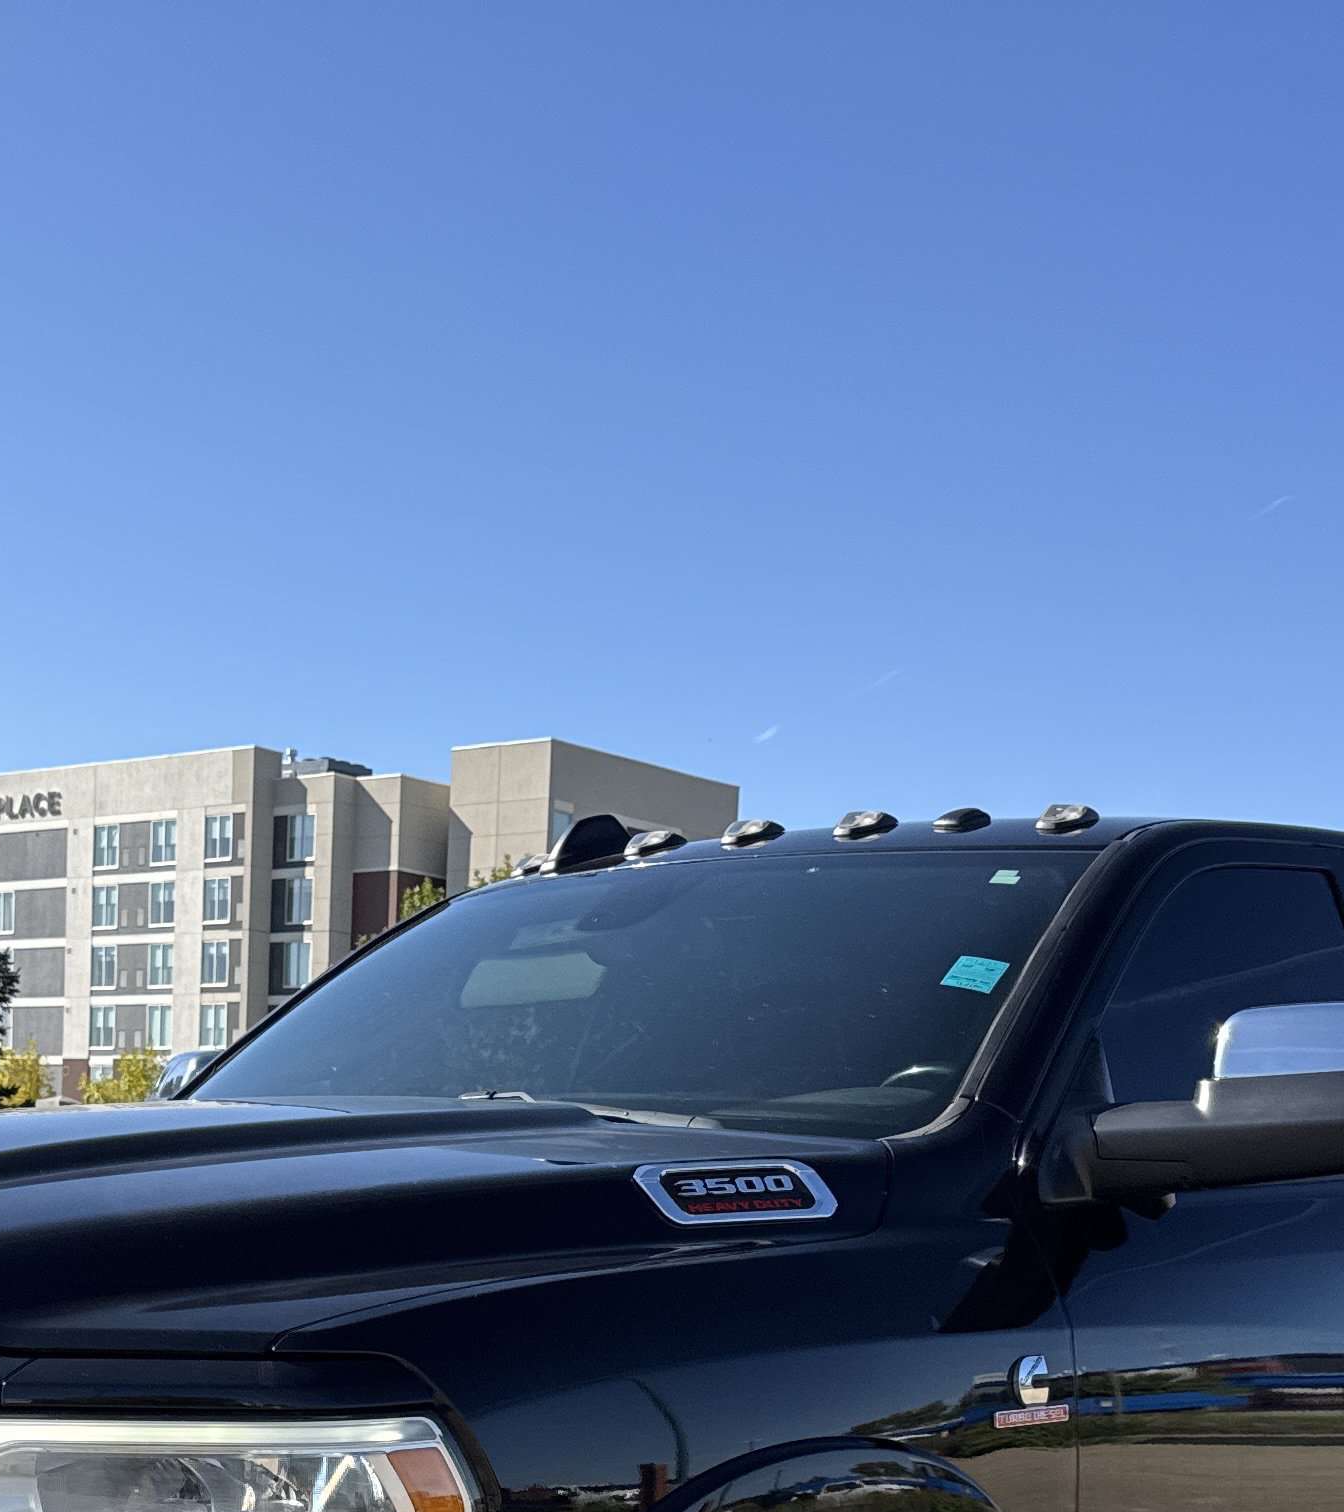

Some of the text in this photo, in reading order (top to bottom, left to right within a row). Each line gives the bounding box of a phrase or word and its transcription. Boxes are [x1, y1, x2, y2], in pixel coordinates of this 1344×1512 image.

[674, 1174, 794, 1196] 3500
[687, 1199, 802, 1213] HEAVY DUTY
